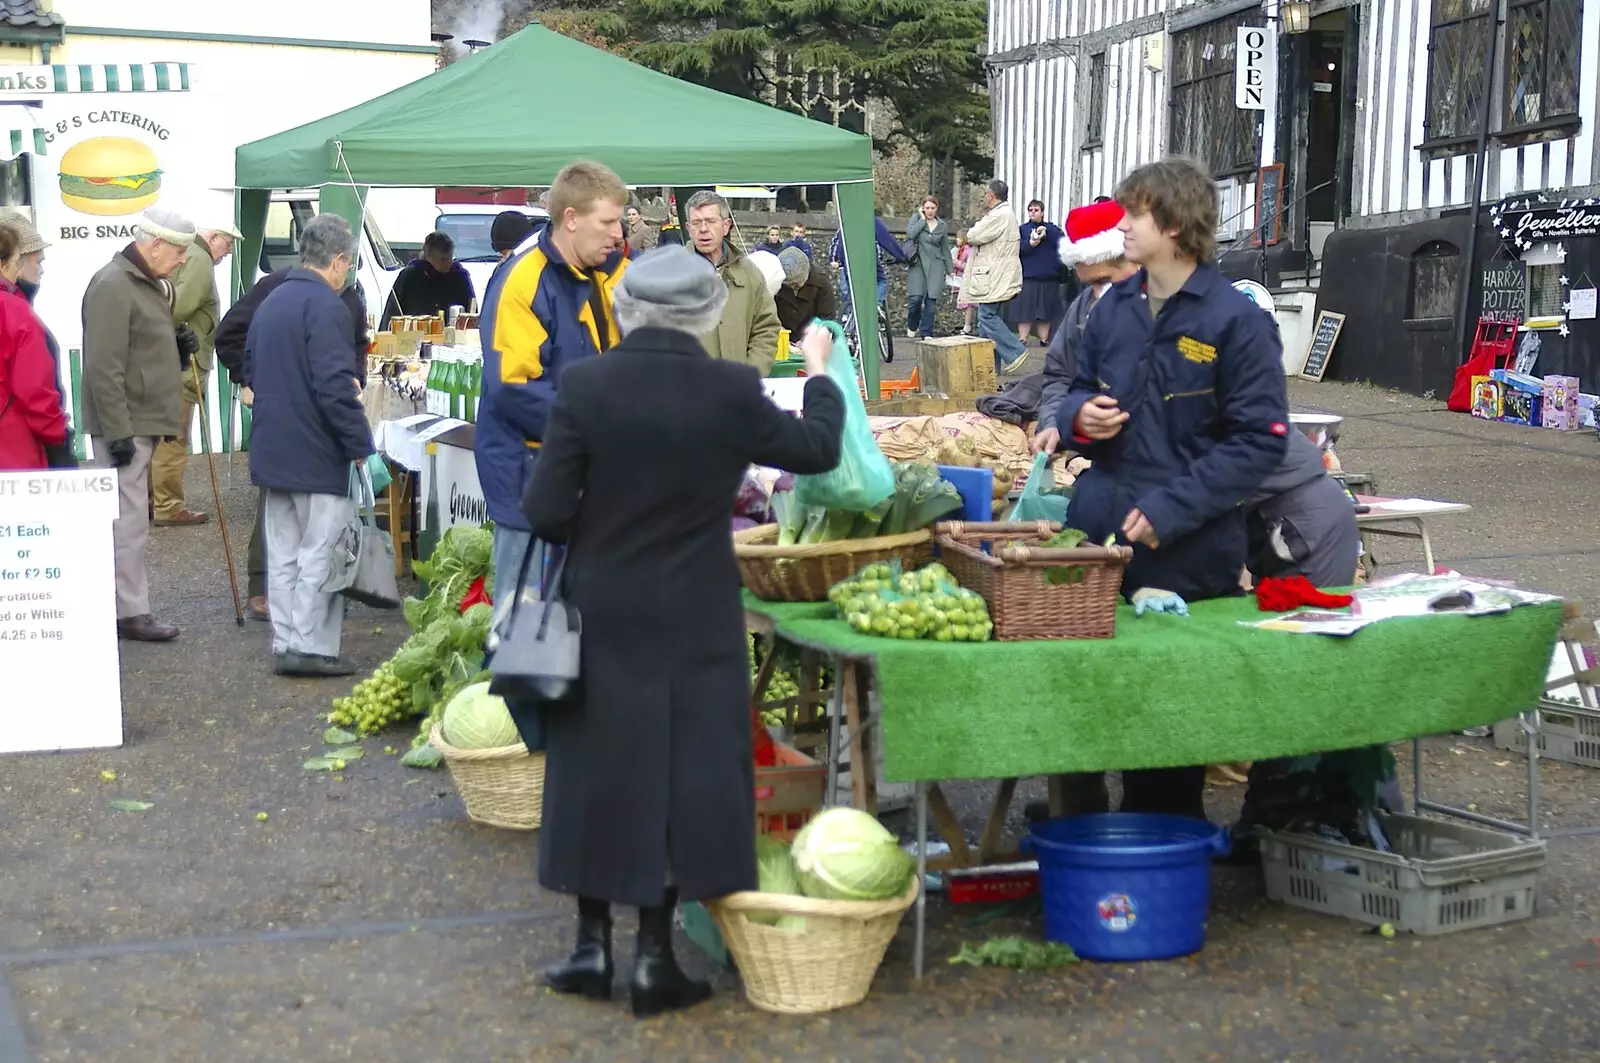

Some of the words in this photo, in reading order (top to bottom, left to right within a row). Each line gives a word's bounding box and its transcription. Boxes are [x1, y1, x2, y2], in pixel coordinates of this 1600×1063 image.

[1244, 31, 1264, 104] OPEN
[56, 120, 68, 133] &
[72, 116, 82, 127] S
[88, 110, 170, 141] CATERING
[60, 226, 89, 239] BIG
[1483, 270, 1521, 288] HARRY
[1483, 290, 1526, 309] POTTER
[1481, 310, 1524, 324] WATCHES
[28, 476, 114, 495] STALKS
[17, 524, 50, 537] Each
[17, 549, 31, 559] or
[2, 569, 20, 580] for
[15, 612, 28, 621] or
[31, 609, 65, 620] White
[30, 631, 37, 639] a
[41, 629, 63, 641] bag
